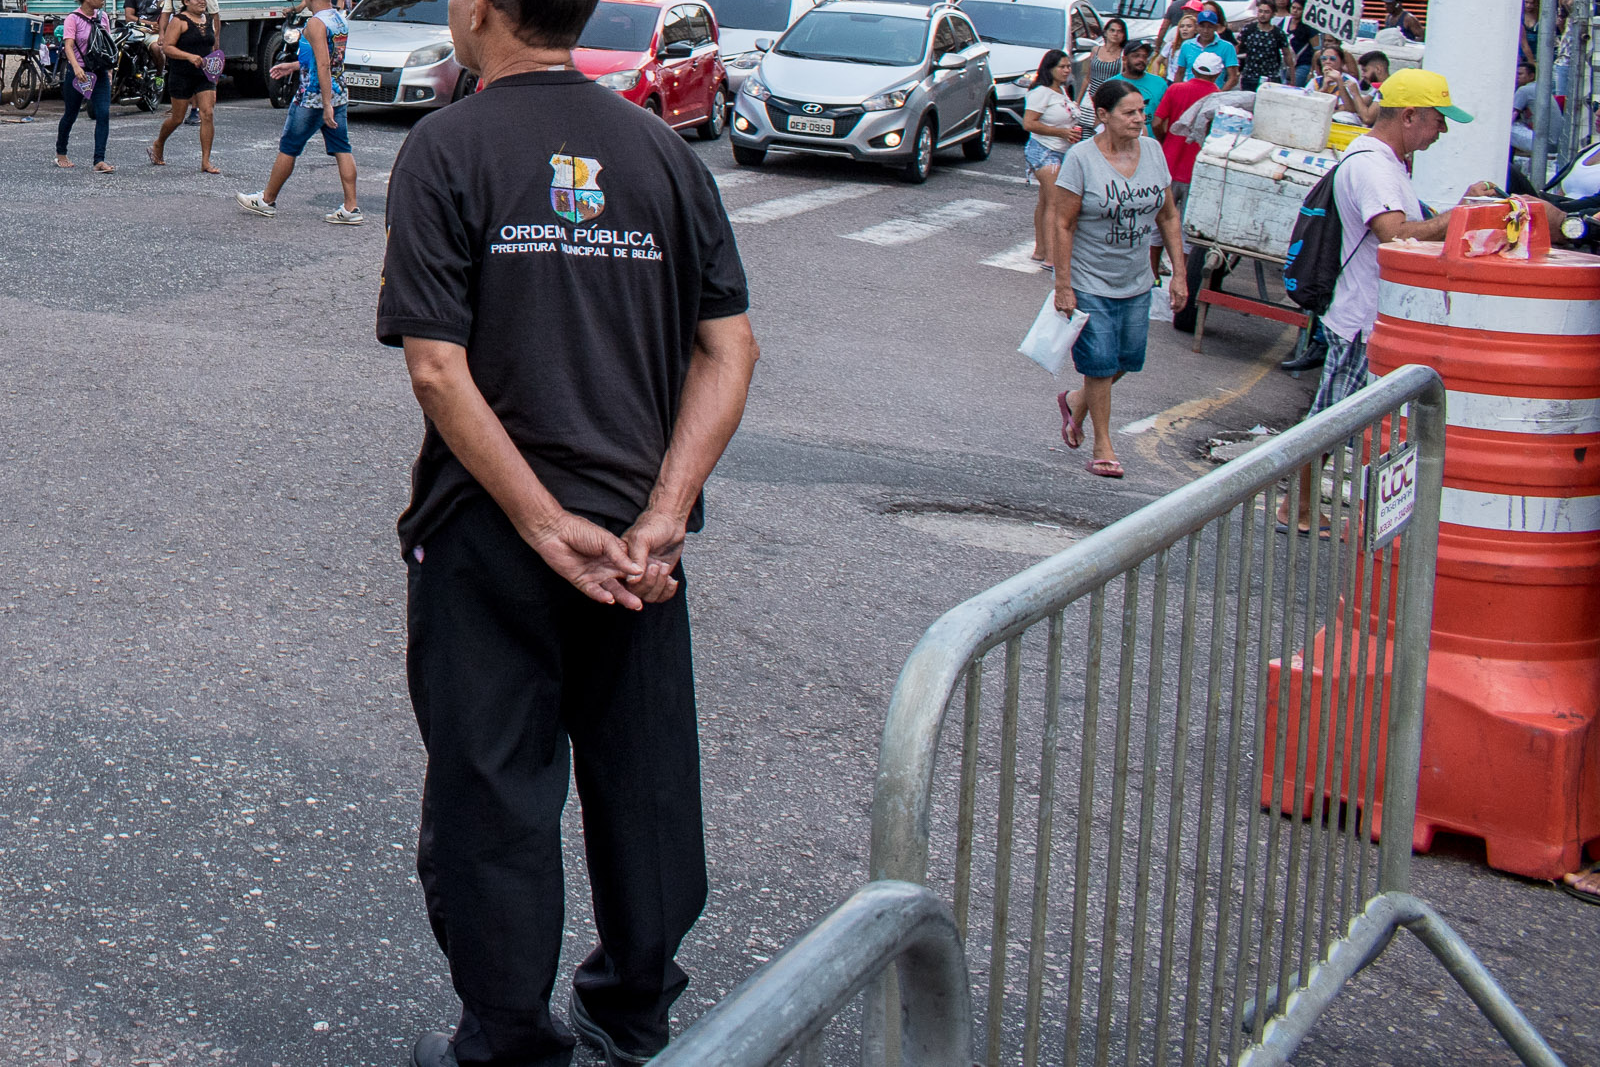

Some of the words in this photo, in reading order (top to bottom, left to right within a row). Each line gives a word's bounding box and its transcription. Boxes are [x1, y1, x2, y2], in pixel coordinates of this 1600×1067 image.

[1305, 4, 1353, 40] AGUA
[1099, 179, 1165, 209] Making
[1101, 203, 1157, 231] Magic
[500, 224, 567, 240] ORDEM
[574, 223, 656, 246] PÚBLICA
[491, 241, 556, 254] PREFEITURA
[561, 245, 609, 257] MUNICIPAL
[613, 247, 628, 258] DE
[631, 246, 662, 261] BELÉM
[1381, 454, 1414, 504] LOC
